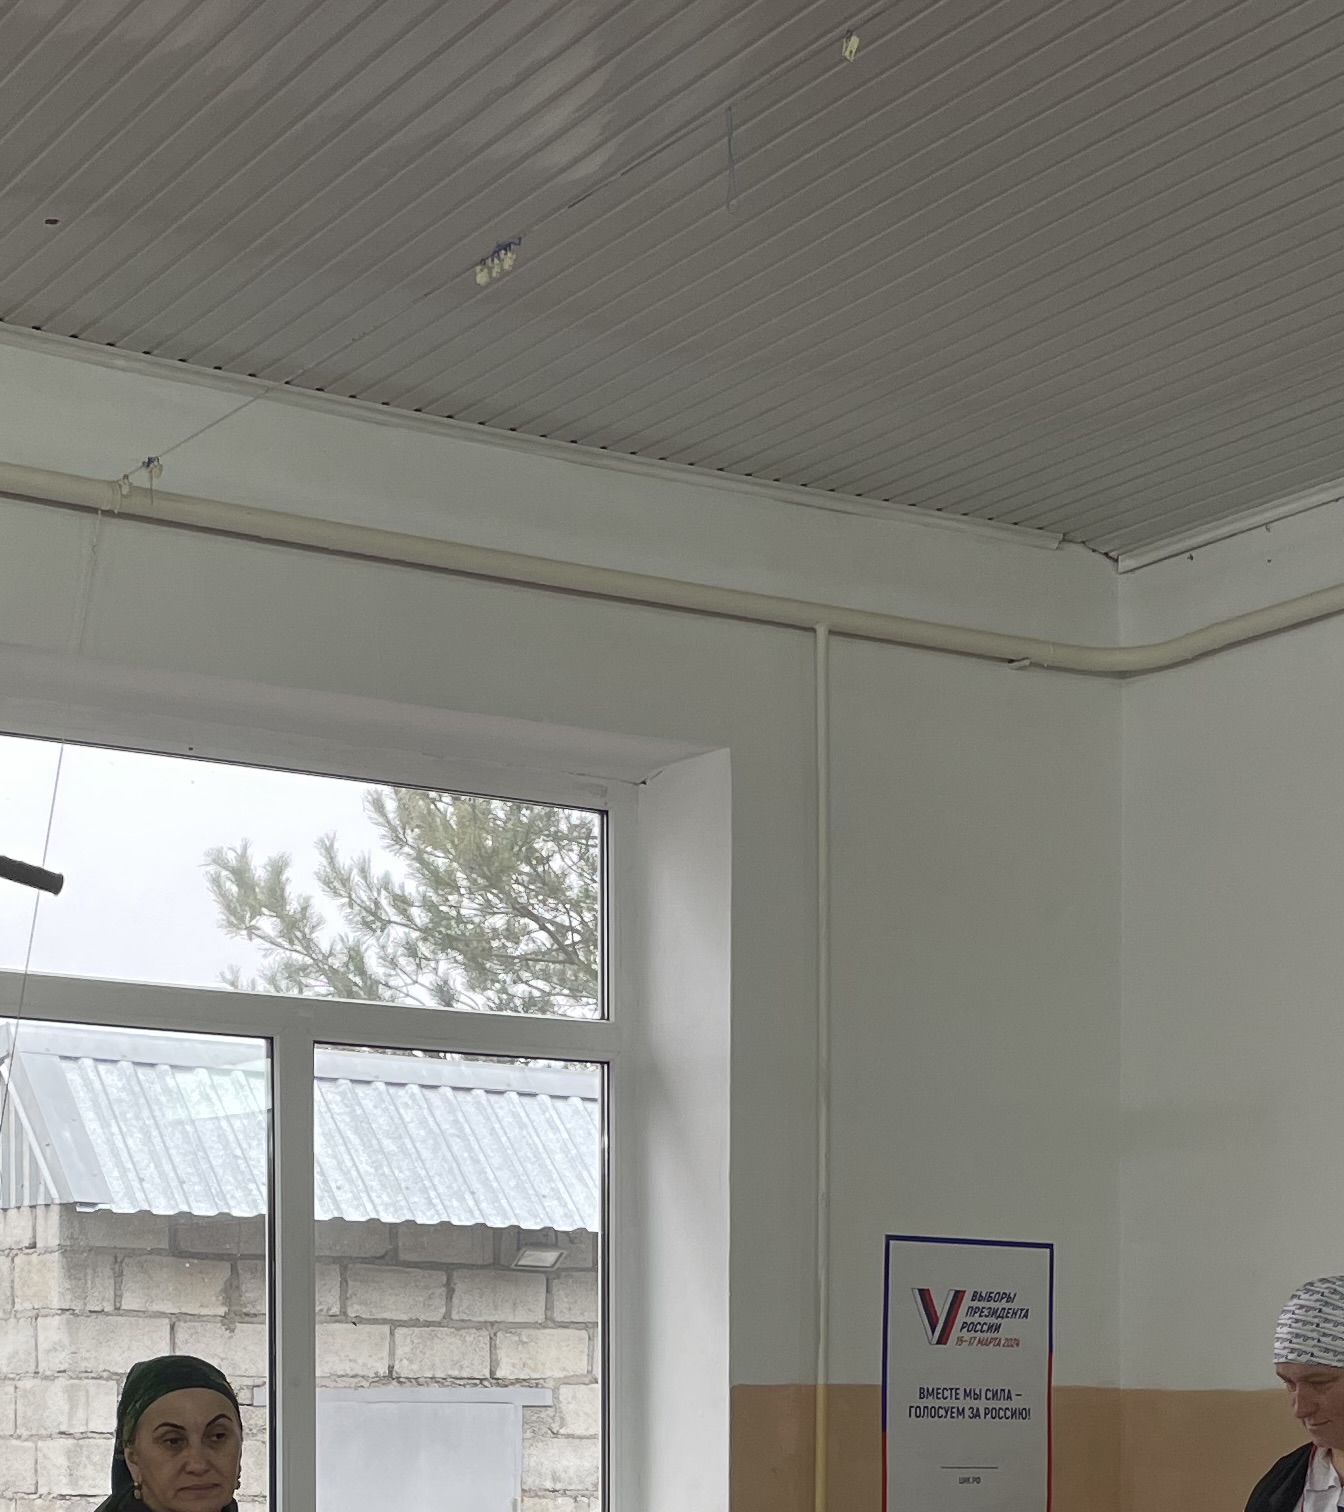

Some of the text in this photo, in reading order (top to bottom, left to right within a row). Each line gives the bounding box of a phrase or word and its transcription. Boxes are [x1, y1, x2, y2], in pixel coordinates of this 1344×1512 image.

[970, 1290, 1016, 1303] ВЫБОРЫ
[965, 1307, 1029, 1320] ПРЕЗИДЕНТА
[960, 1322, 1002, 1334] РОССИИ
[977, 1337, 1002, 1347] МАРТА
[1003, 1338, 1020, 1348] 2024
[918, 1387, 960, 1401] ВМЕСТЕ
[963, 1388, 982, 1401] МЫ
[985, 1388, 1012, 1402] СИЛА
[908, 1405, 1031, 1421] ГОЛОСУЕМ ЗА РОССИЮ!
